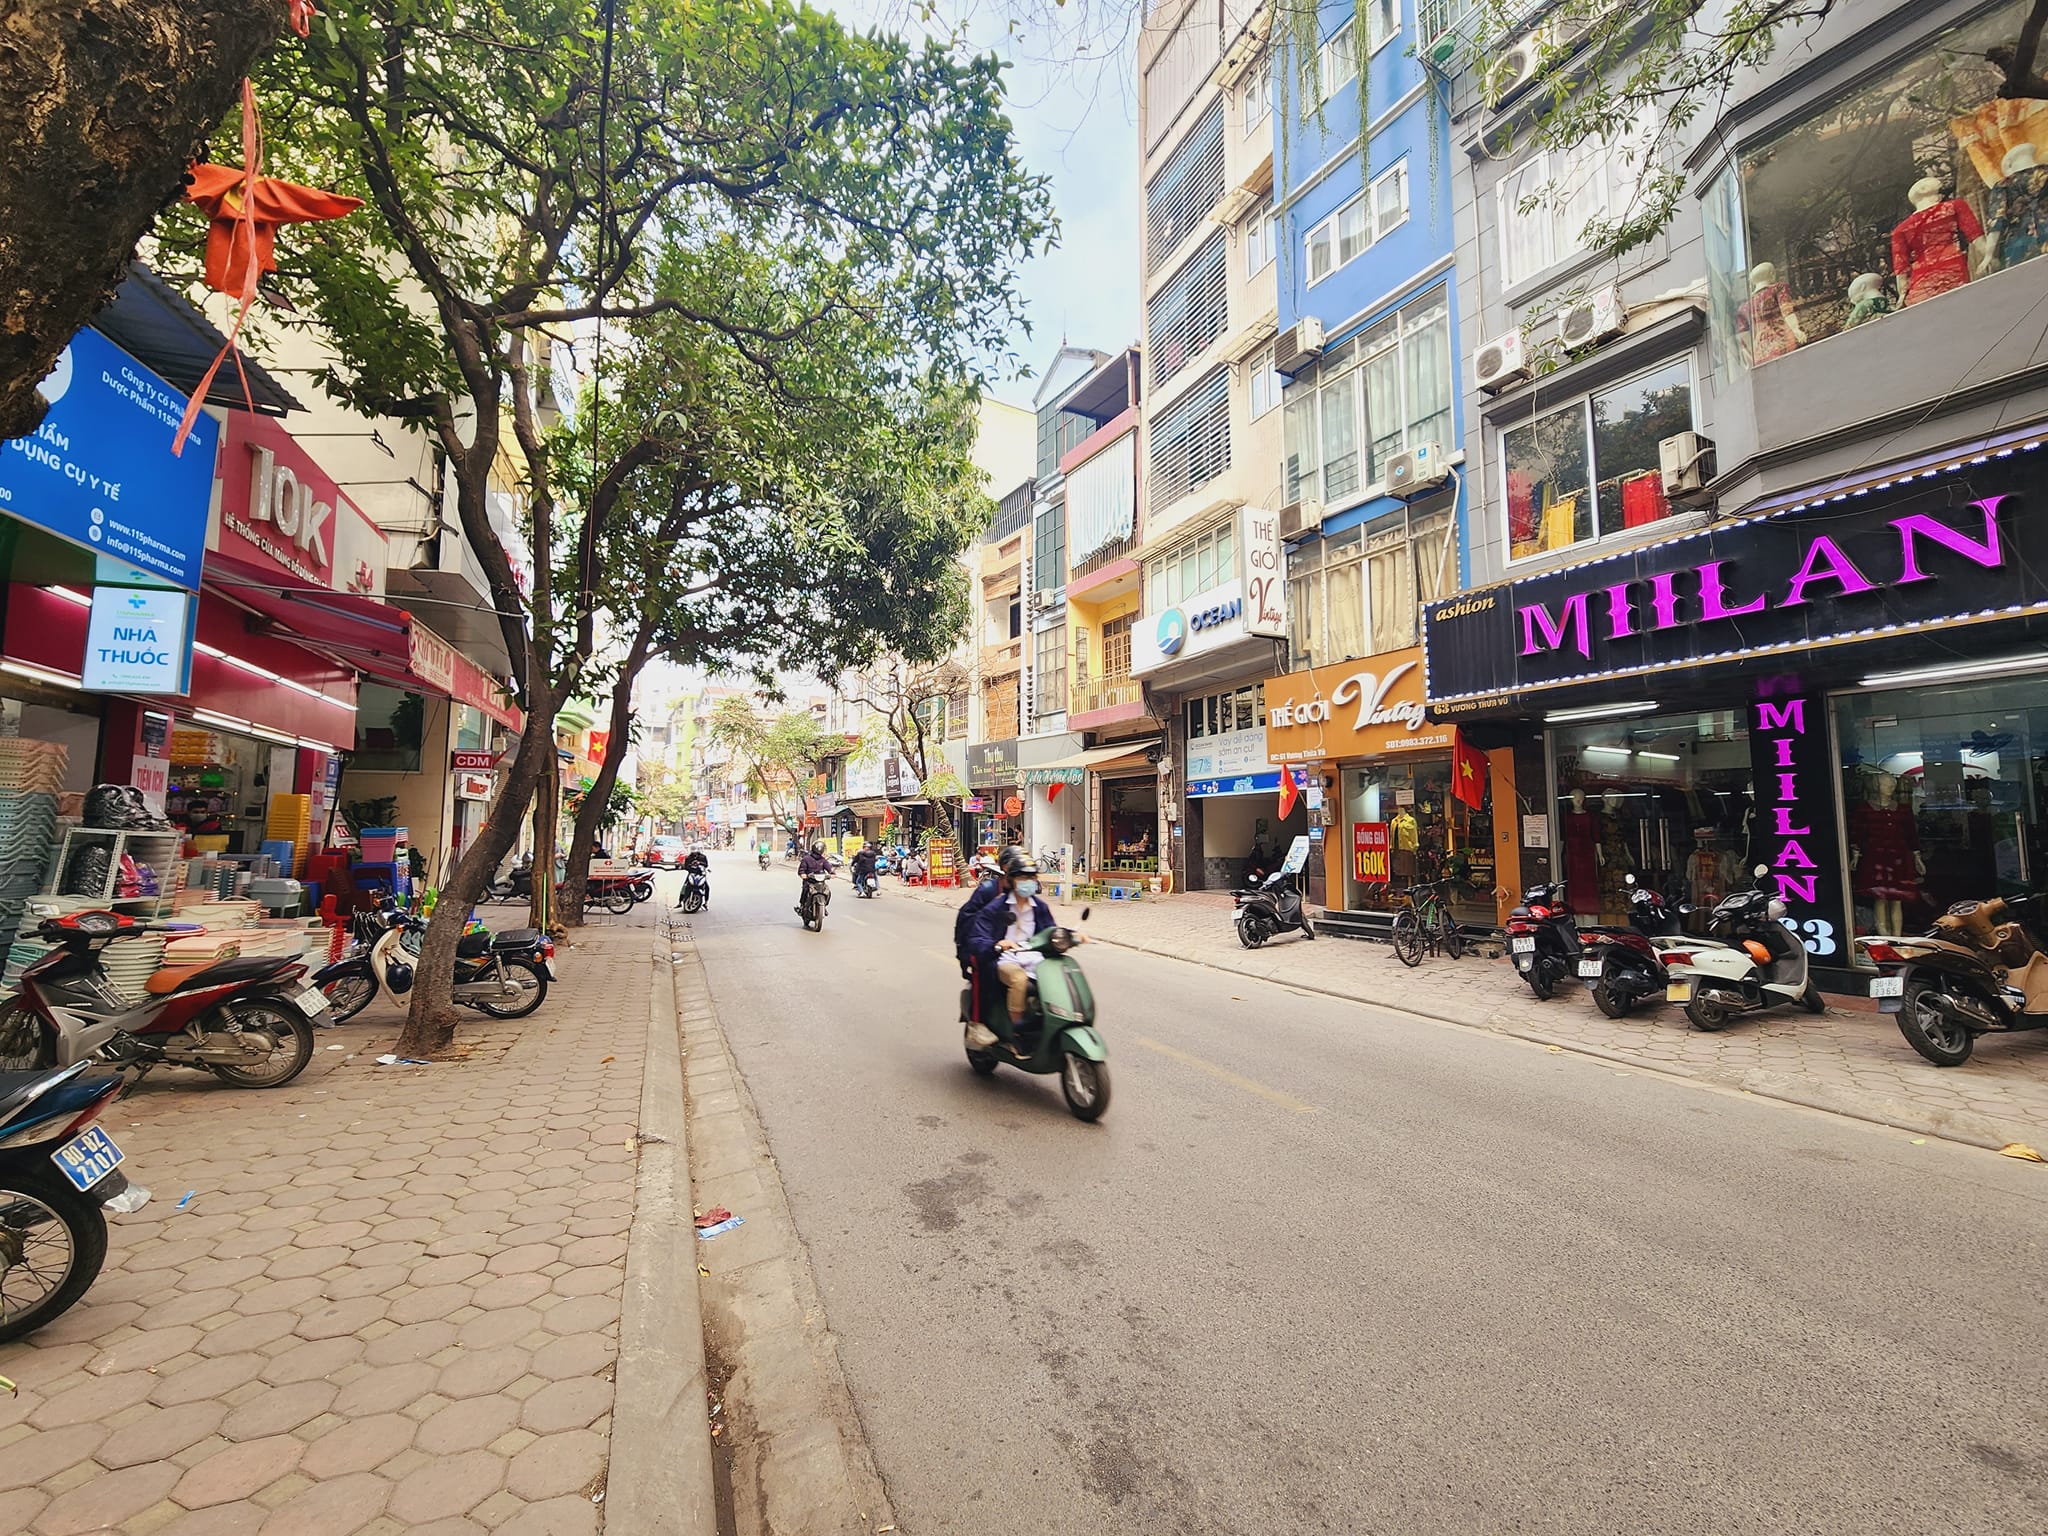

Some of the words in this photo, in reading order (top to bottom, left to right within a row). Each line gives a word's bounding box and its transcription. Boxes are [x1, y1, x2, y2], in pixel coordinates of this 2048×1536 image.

[102, 370, 124, 397] Dược
[125, 390, 156, 415] Phẩm
[121, 366, 145, 392] Công
[145, 383, 157, 399] Ty
[11, 438, 61, 470] DỤNG
[64, 462, 86, 486] CỤ
[89, 474, 100, 489] Y
[102, 481, 122, 502] TẾ
[245, 441, 332, 568] 10K
[109, 518, 187, 562] www.115pharma.com
[236, 520, 260, 546] THỐNG
[1253, 518, 1275, 541] THẾ
[1250, 546, 1279, 571] GIỚI
[1516, 494, 2012, 660] MIILAN
[1249, 577, 1282, 632] Vintage
[1435, 595, 1496, 622] ashion
[98, 645, 169, 666] THUỐC
[1269, 697, 1295, 728] THẾ
[1293, 692, 1332, 725] GIỚI
[1331, 660, 1426, 732] Vintag
[1433, 701, 1450, 715] 63
[456, 756, 490, 767] CDM
[1755, 699, 1819, 904] MIILAN
[1356, 851, 1386, 875] 160K
[76, 1145, 117, 1184] 2707
